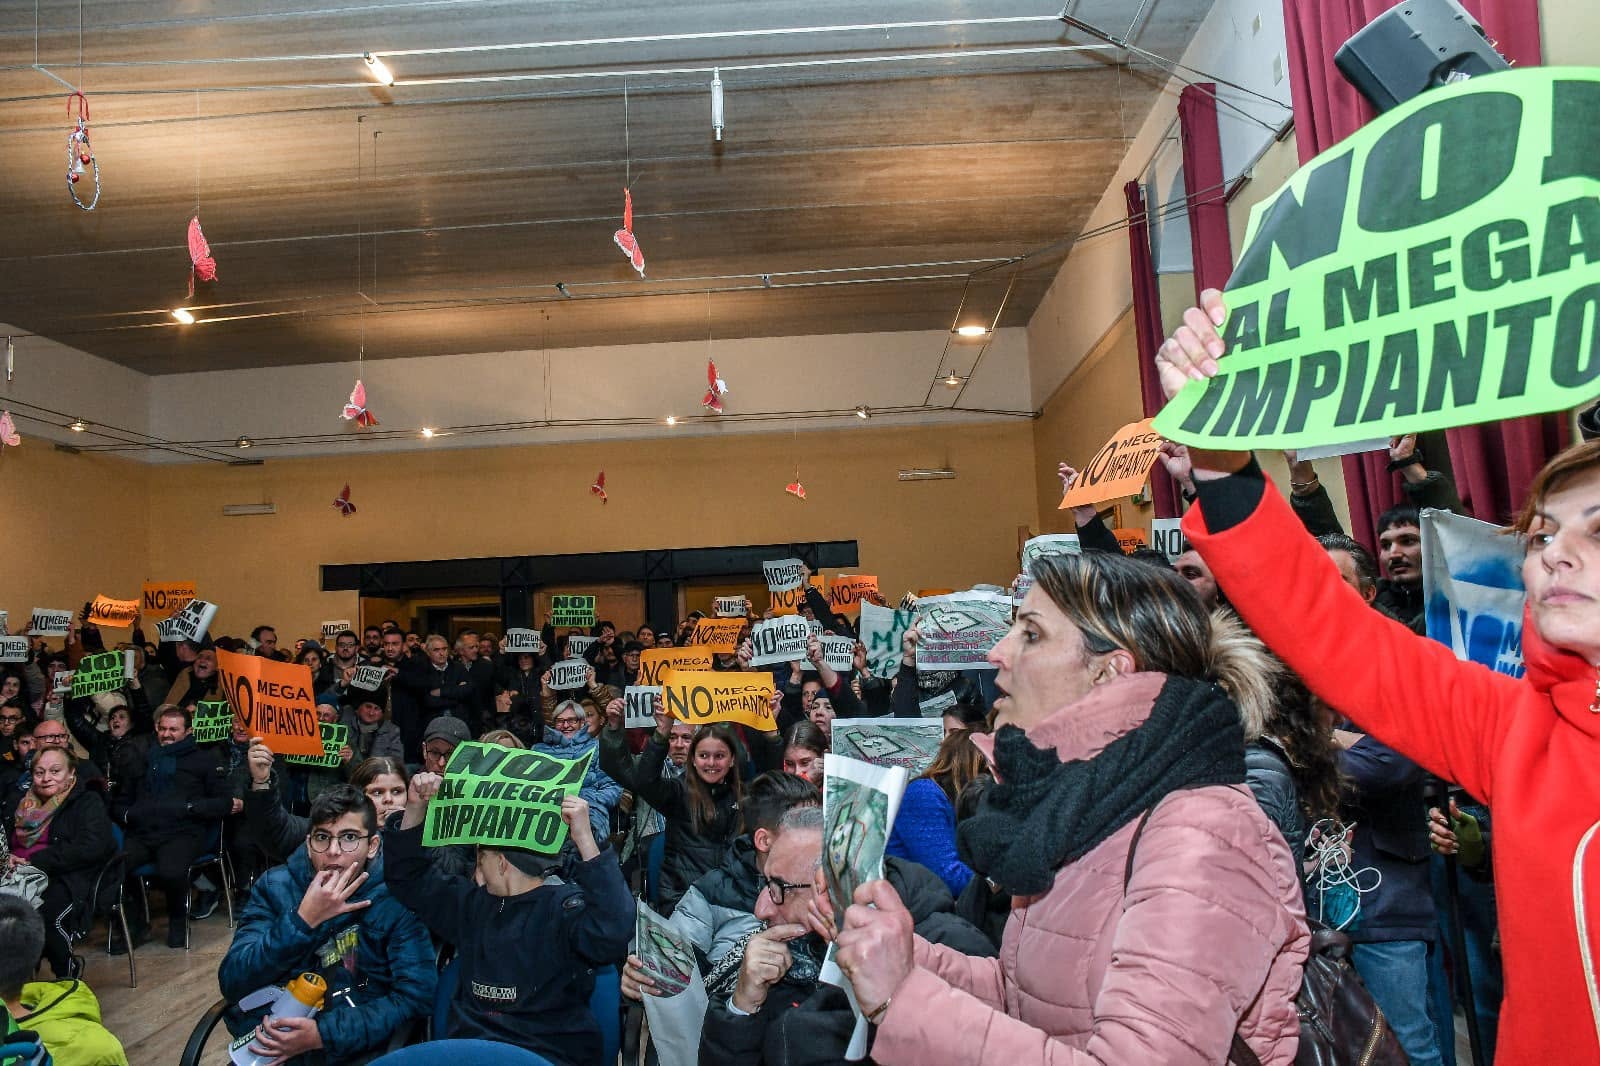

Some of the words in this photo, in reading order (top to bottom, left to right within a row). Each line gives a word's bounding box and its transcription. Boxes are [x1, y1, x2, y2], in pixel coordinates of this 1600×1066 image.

[1222, 288, 1300, 356] AL
[1324, 195, 1600, 330] MEGA
[1179, 282, 1600, 437] IMPIANTO
[1070, 441, 1118, 491] NO
[1103, 448, 1160, 483] IMPIANTO
[1154, 529, 1182, 557] NO
[765, 567, 785, 586] NO
[144, 590, 166, 610] NO
[772, 589, 796, 609] NO
[831, 585, 852, 606] NO
[93, 601, 113, 618] NO
[32, 614, 48, 631] NO
[48, 615, 69, 625] MEGA
[322, 624, 335, 636] NO
[506, 633, 521, 648] NO
[521, 633, 539, 641] MEGA
[691, 624, 716, 645] NO
[751, 627, 778, 657] NO
[776, 623, 807, 640] MEGA
[5, 641, 27, 651] MEGA
[569, 640, 583, 655] NO
[825, 641, 853, 654] MEGA
[672, 657, 711, 666] MEGA
[550, 666, 567, 686] NO
[219, 668, 254, 729] NO
[257, 679, 311, 702] MEGA
[626, 692, 653, 719] NO
[666, 685, 714, 719] NO
[713, 685, 772, 696] MEGA
[716, 694, 770, 719] IMPIANTO
[255, 701, 315, 737] IMPIANTO
[437, 779, 467, 801] AL
[472, 781, 566, 807] MEGA
[431, 804, 562, 847] IMPIANTO
